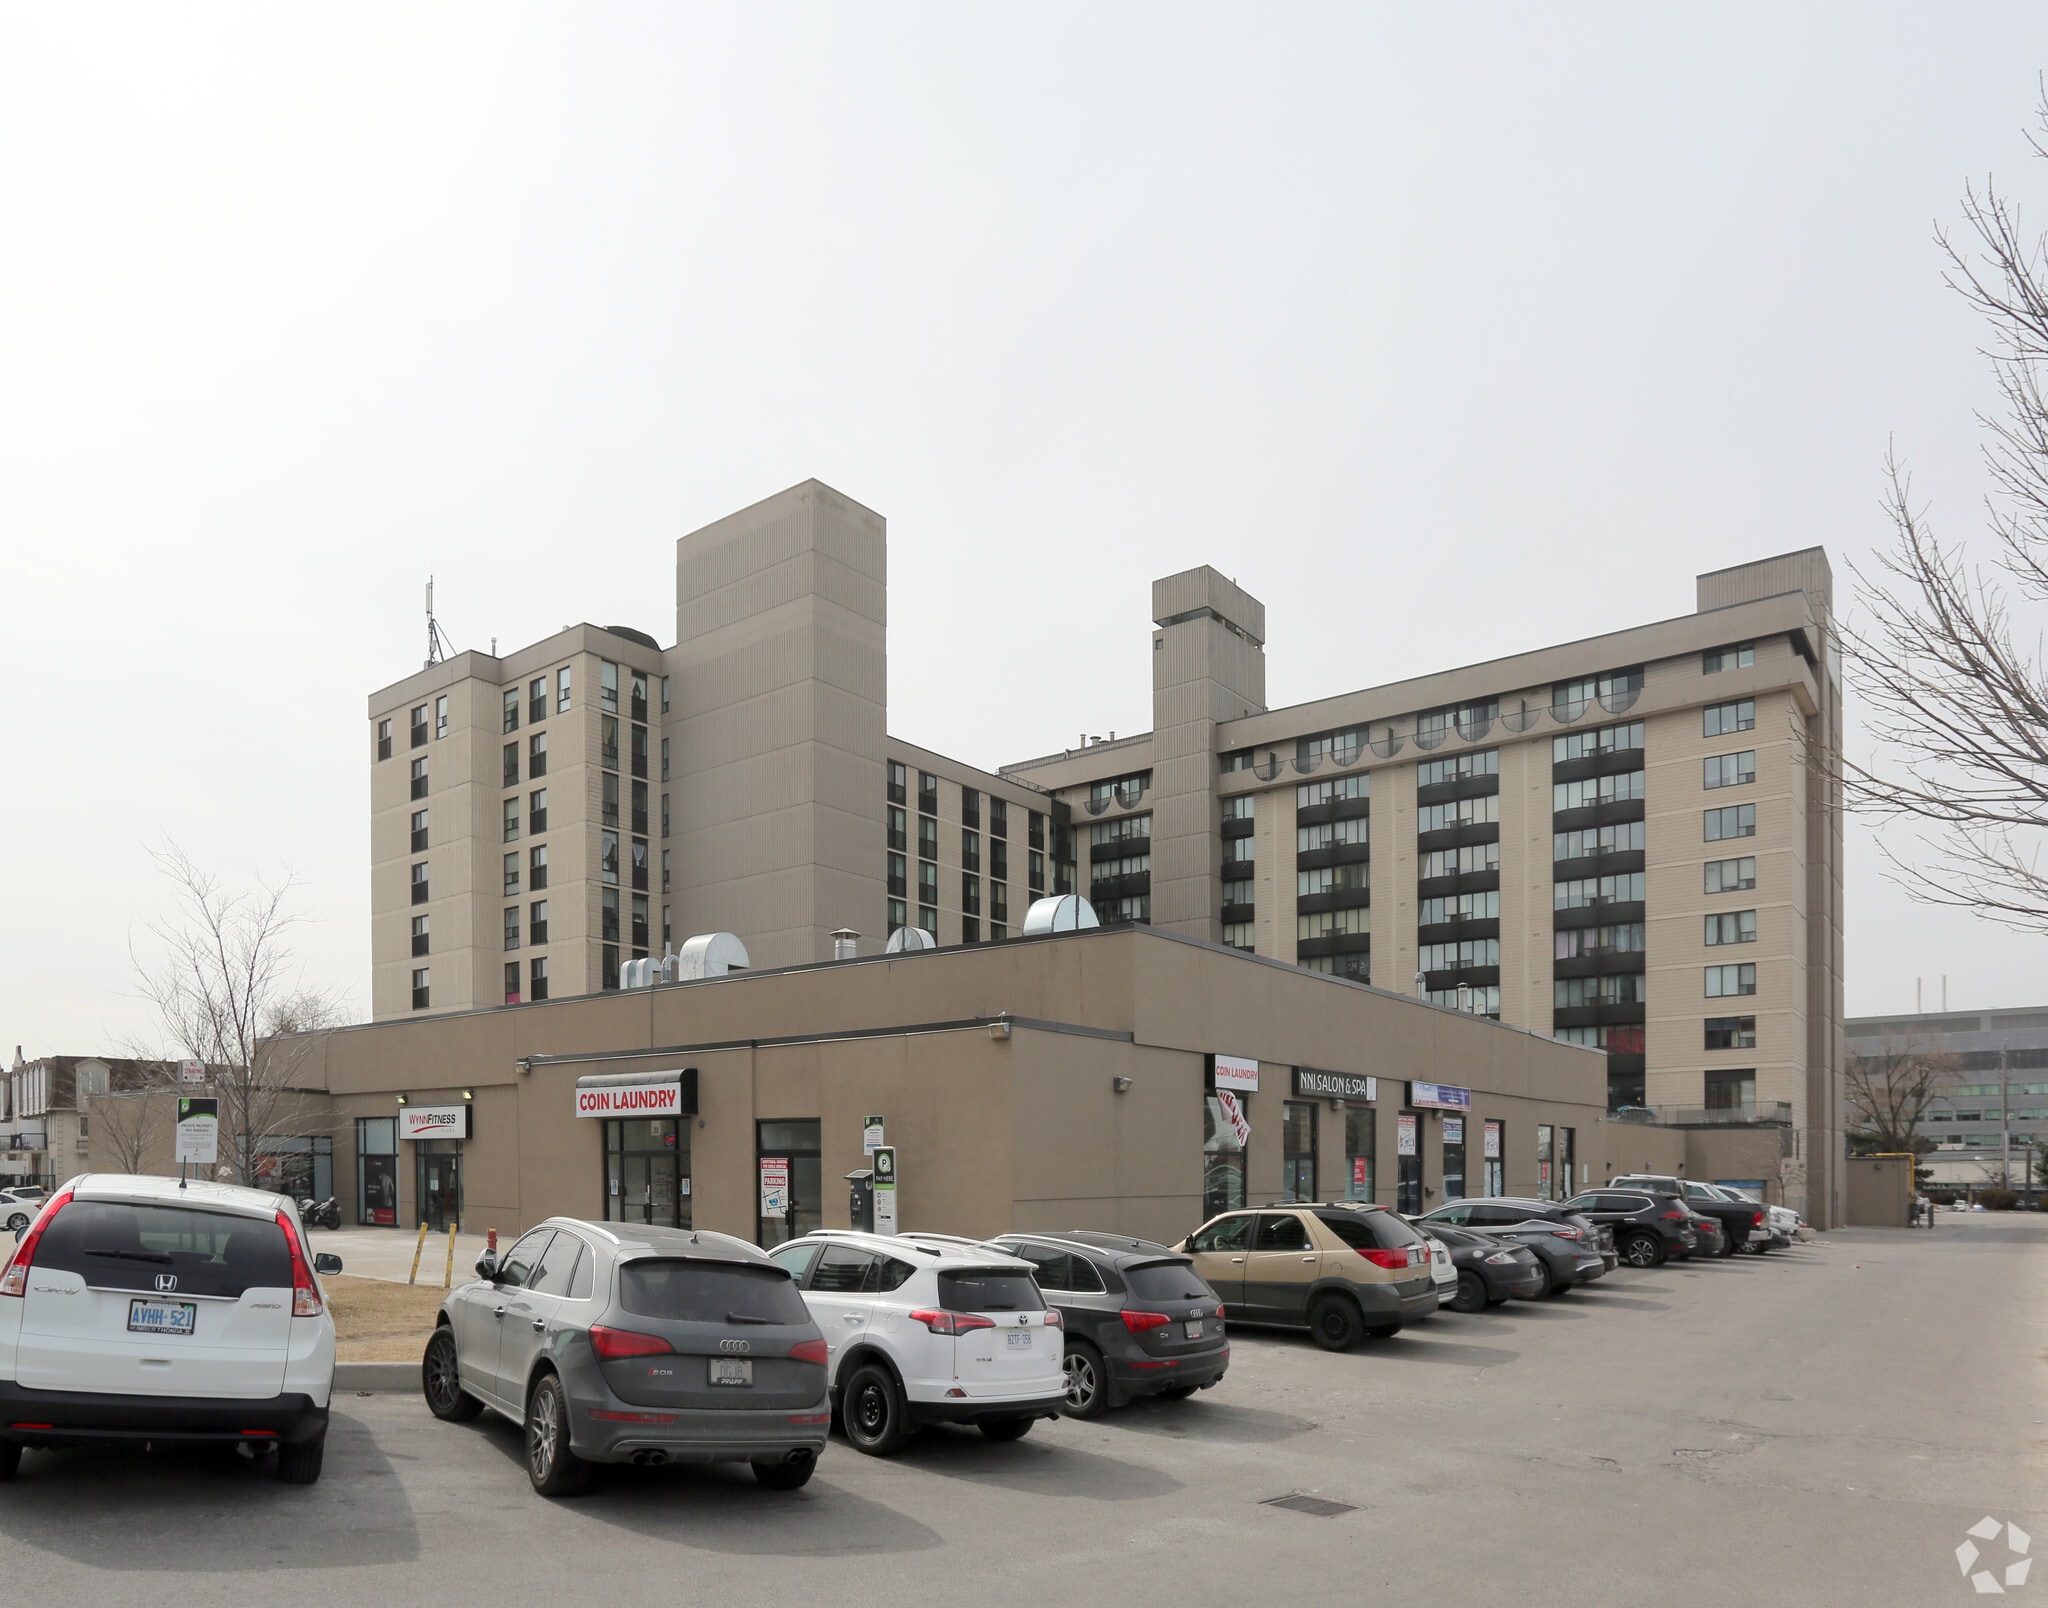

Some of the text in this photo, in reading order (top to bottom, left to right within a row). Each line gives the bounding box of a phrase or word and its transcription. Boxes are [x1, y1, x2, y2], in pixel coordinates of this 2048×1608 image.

[1216, 1065, 1258, 1080] COIN LAUNDRY
[1317, 1074, 1345, 1093] SALON
[1345, 1078, 1351, 1094] &
[1351, 1079, 1366, 1095] SPA
[580, 1089, 676, 1111] COIN LAUNDRY
[764, 1177, 786, 1185] PARKING
[132, 1307, 192, 1327] AVHH 521
